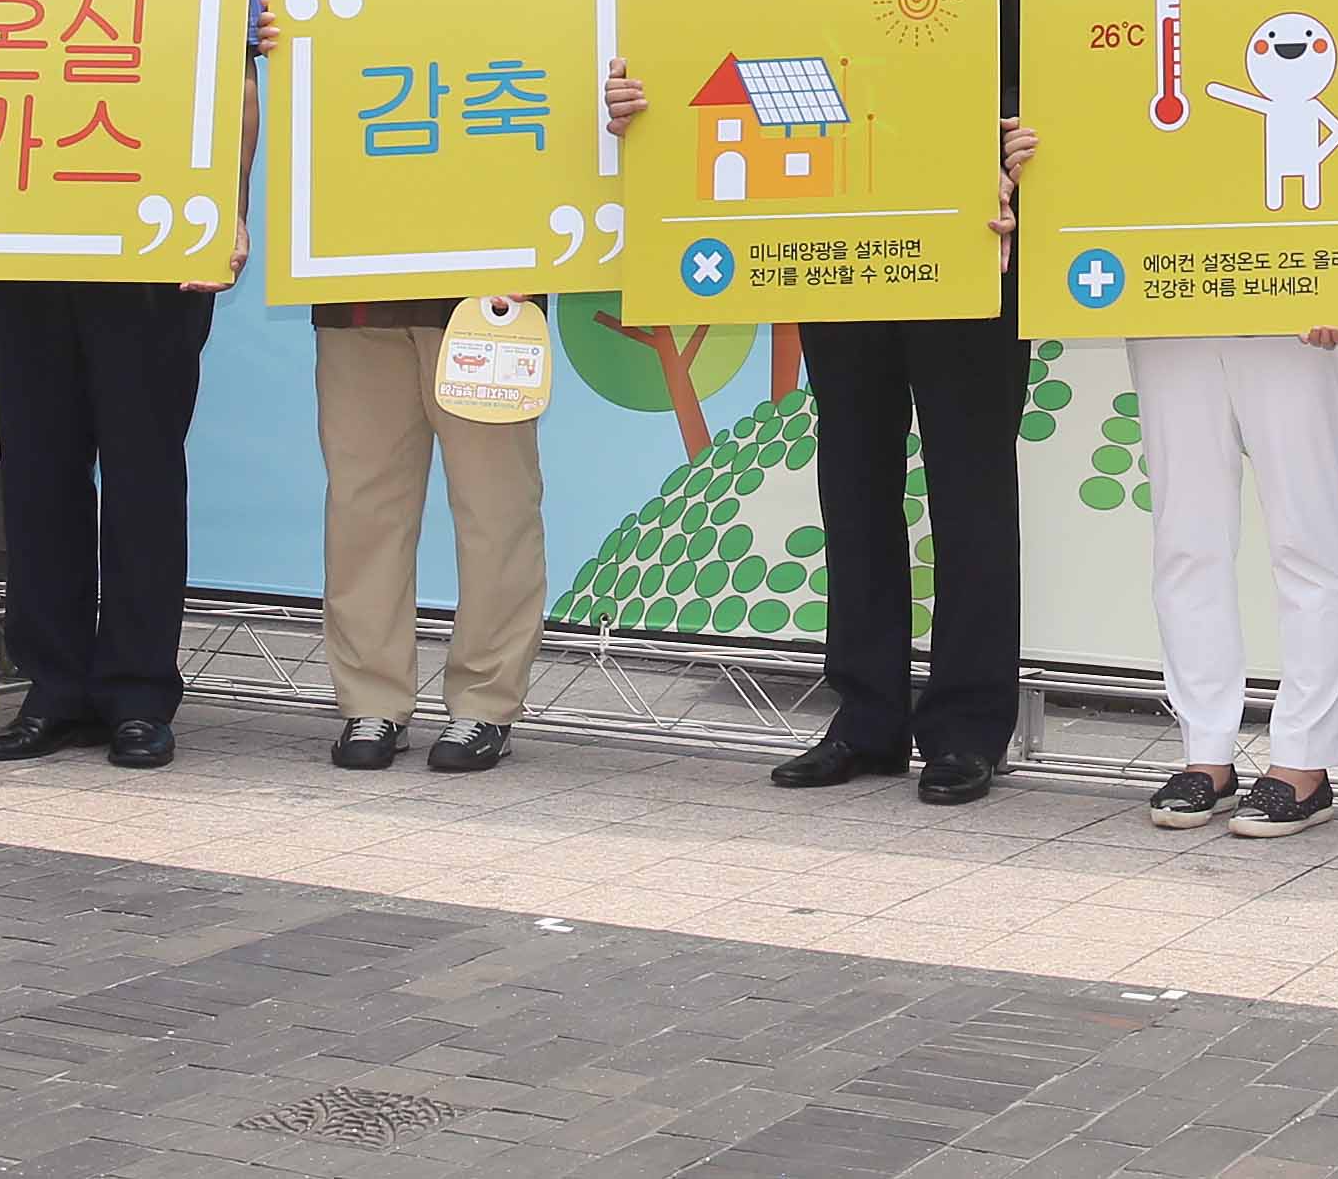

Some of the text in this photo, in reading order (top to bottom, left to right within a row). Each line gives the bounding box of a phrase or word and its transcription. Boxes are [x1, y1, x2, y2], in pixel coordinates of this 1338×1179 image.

[357, 59, 552, 157] 감축
[749, 237, 921, 262] 미니태양광을 설치하면
[1143, 253, 1195, 273] 에어컨
[1201, 252, 1272, 272] 설정온도
[1278, 252, 1307, 269] 2도
[749, 263, 940, 287] 전기를 생산할 수 있어요!
[1143, 276, 1319, 299] 건강한 여름 보내세요!
